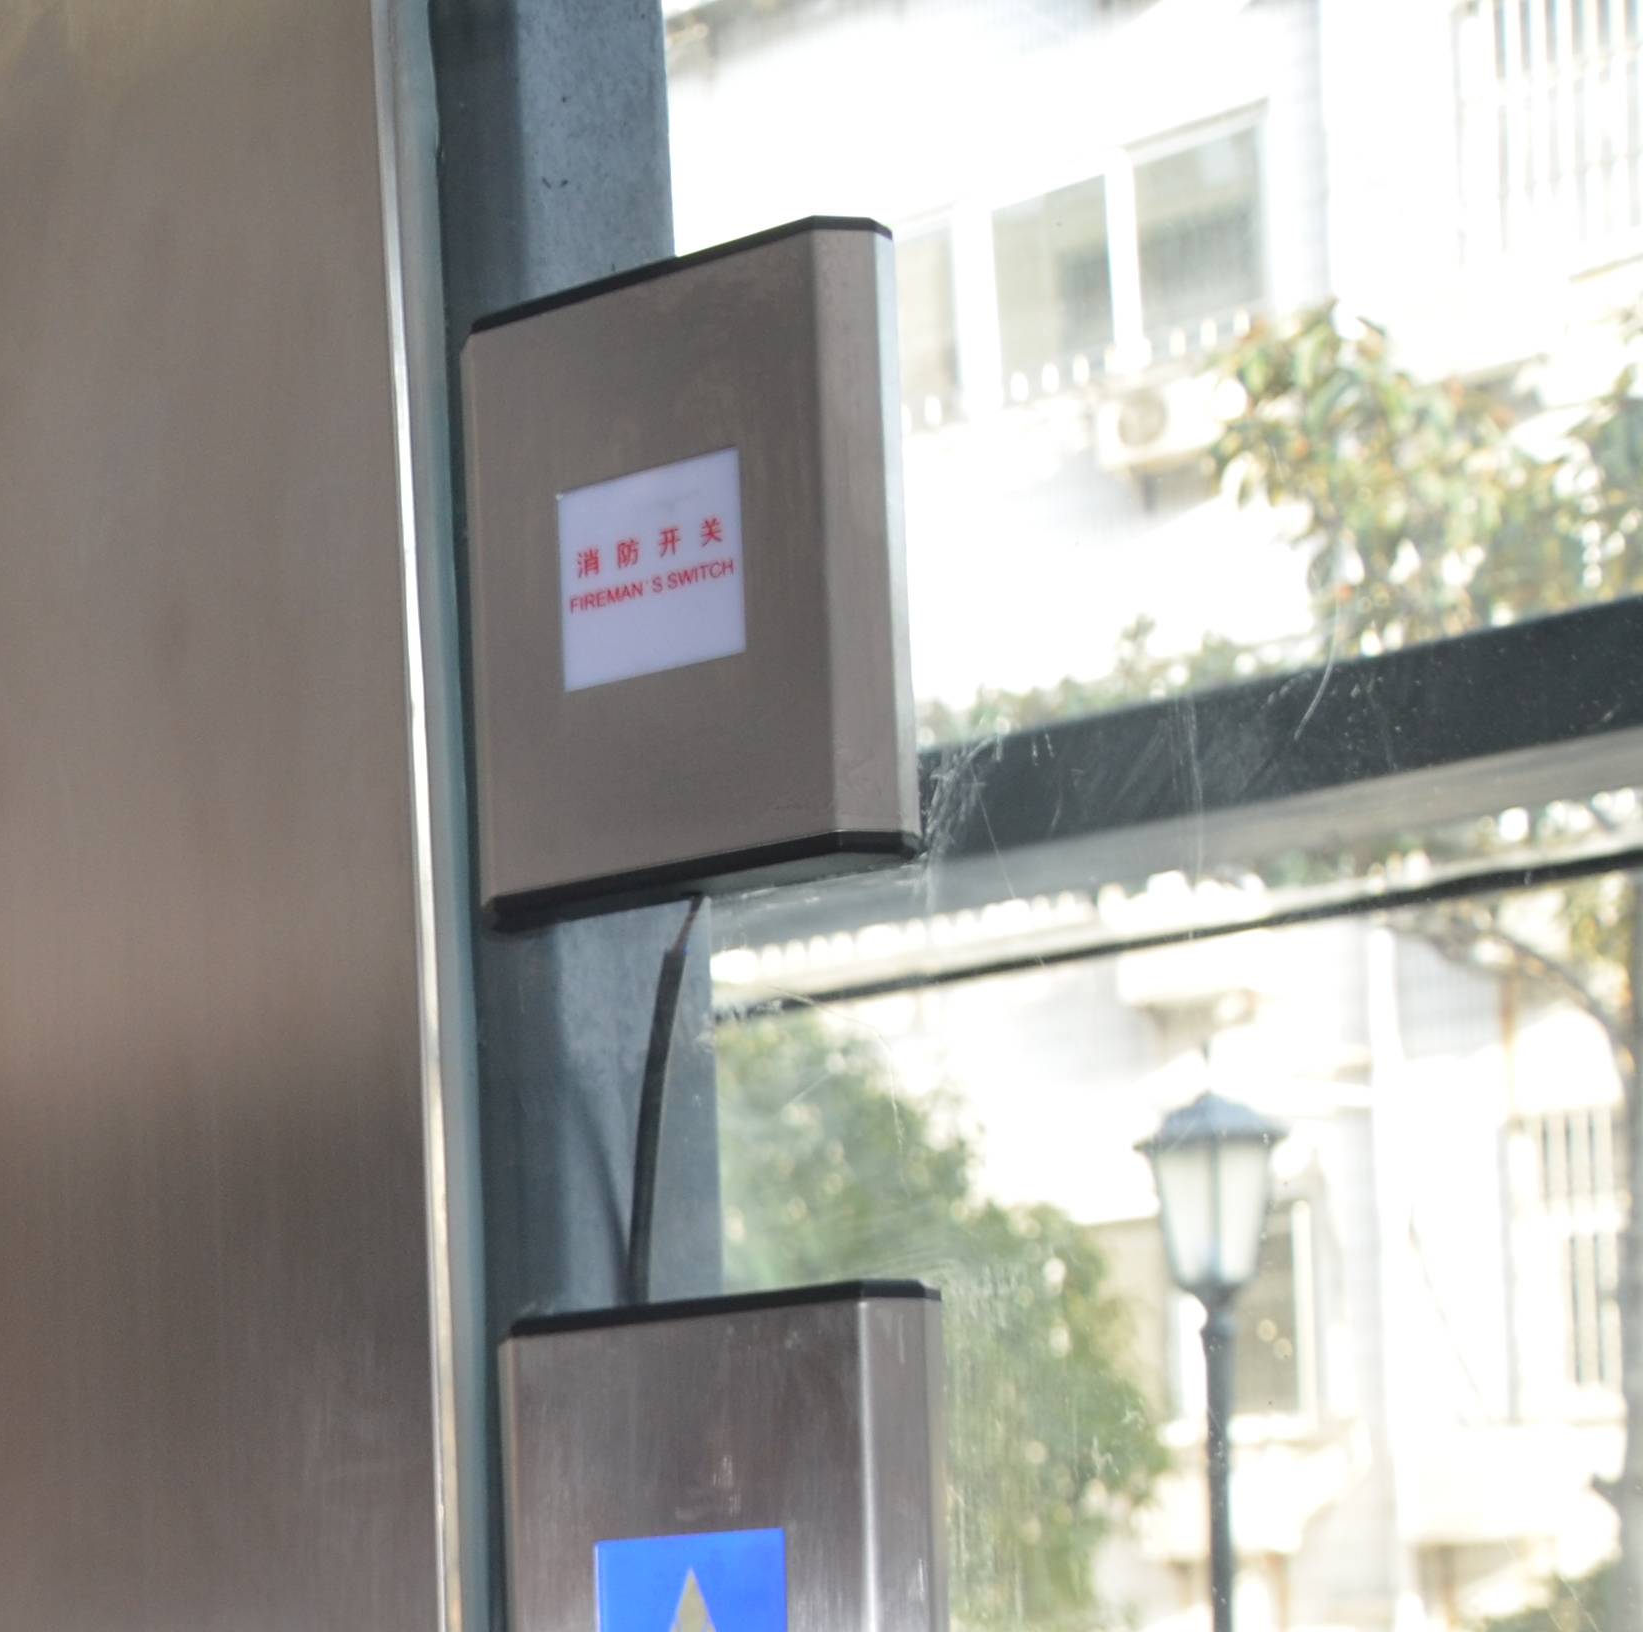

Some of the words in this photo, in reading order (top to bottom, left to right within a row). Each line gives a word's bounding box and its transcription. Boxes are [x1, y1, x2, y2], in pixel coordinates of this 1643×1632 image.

[577, 516, 723, 578] 消防开关
[667, 559, 735, 590] SWITCH
